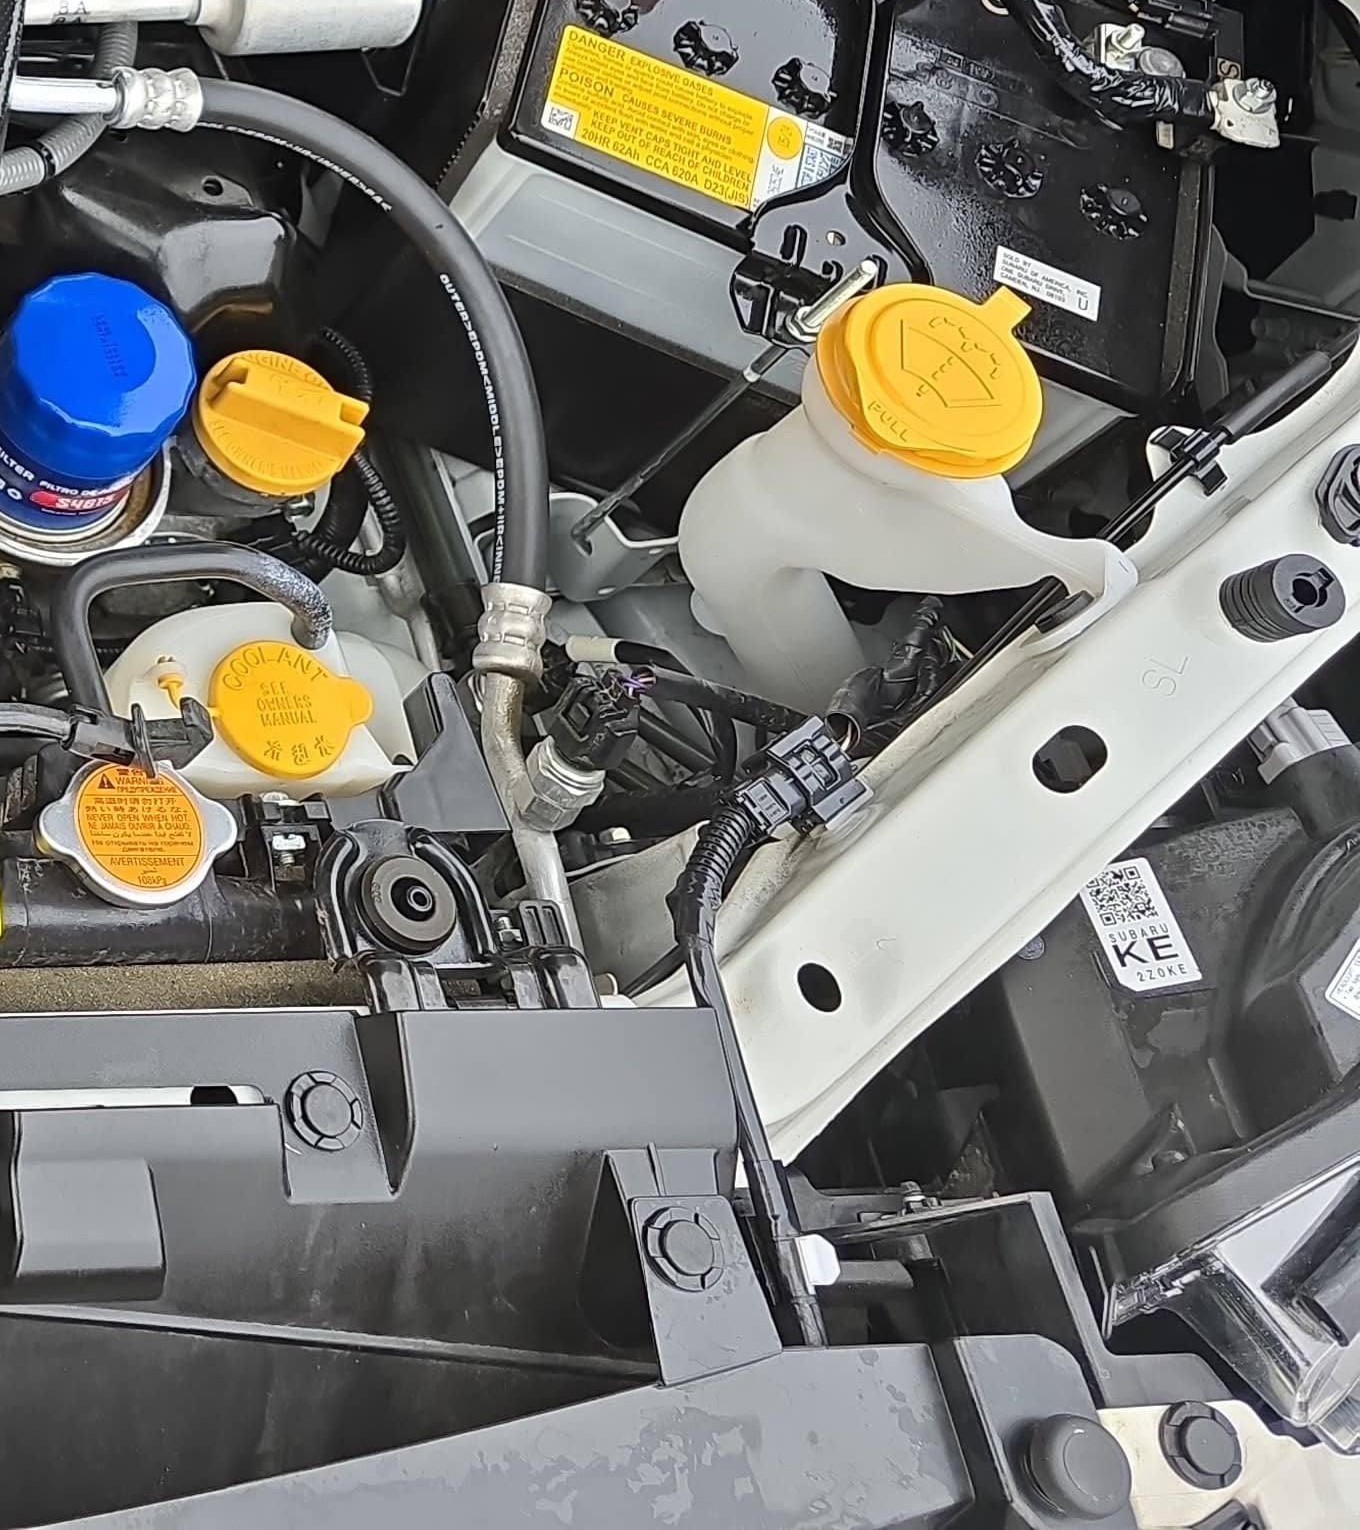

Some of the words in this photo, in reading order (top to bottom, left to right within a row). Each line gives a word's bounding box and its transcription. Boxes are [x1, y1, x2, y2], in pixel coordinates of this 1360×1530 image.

[568, 29, 625, 61] DANGER
[630, 56, 680, 83] EXPLOSIVE
[682, 77, 713, 96] GASES
[558, 67, 614, 98] POISON
[621, 93, 659, 115] CAUSES
[660, 109, 697, 130] SEVERE
[699, 124, 731, 145] BURNS
[590, 118, 615, 136] KEEP
[616, 129, 636, 145] OUT
[637, 138, 650, 150] OF
[653, 144, 685, 165] REACH
[687, 159, 700, 171] OF
[701, 165, 749, 192] CHILDREN
[592, 109, 617, 126] KEEP
[618, 120, 643, 137] VENT
[645, 131, 670, 149] CAPS
[673, 142, 699, 160] TIGHT
[701, 154, 721, 169] AND
[722, 163, 752, 183] LEVEL
[581, 127, 610, 148] 20HR
[612, 140, 640, 161] 62Ah
[645, 154, 670, 173] CCA
[671, 164, 699, 185] 620A
[703, 177, 749, 206] D23(JIS)
[867, 400, 908, 442] PULL
[39, 480, 79, 496] FILTRO
[222, 646, 328, 691] COOLANT
[260, 680, 288, 696] SEE
[259, 709, 316, 727] MANUAL
[86, 814, 114, 822] NEVER
[117, 814, 140, 822] OPEN
[143, 814, 168, 822] WHEN
[110, 857, 185, 866] AVERTISSEMENT
[1108, 923, 1169, 943] SUBARU
[1112, 934, 1180, 968] KE
